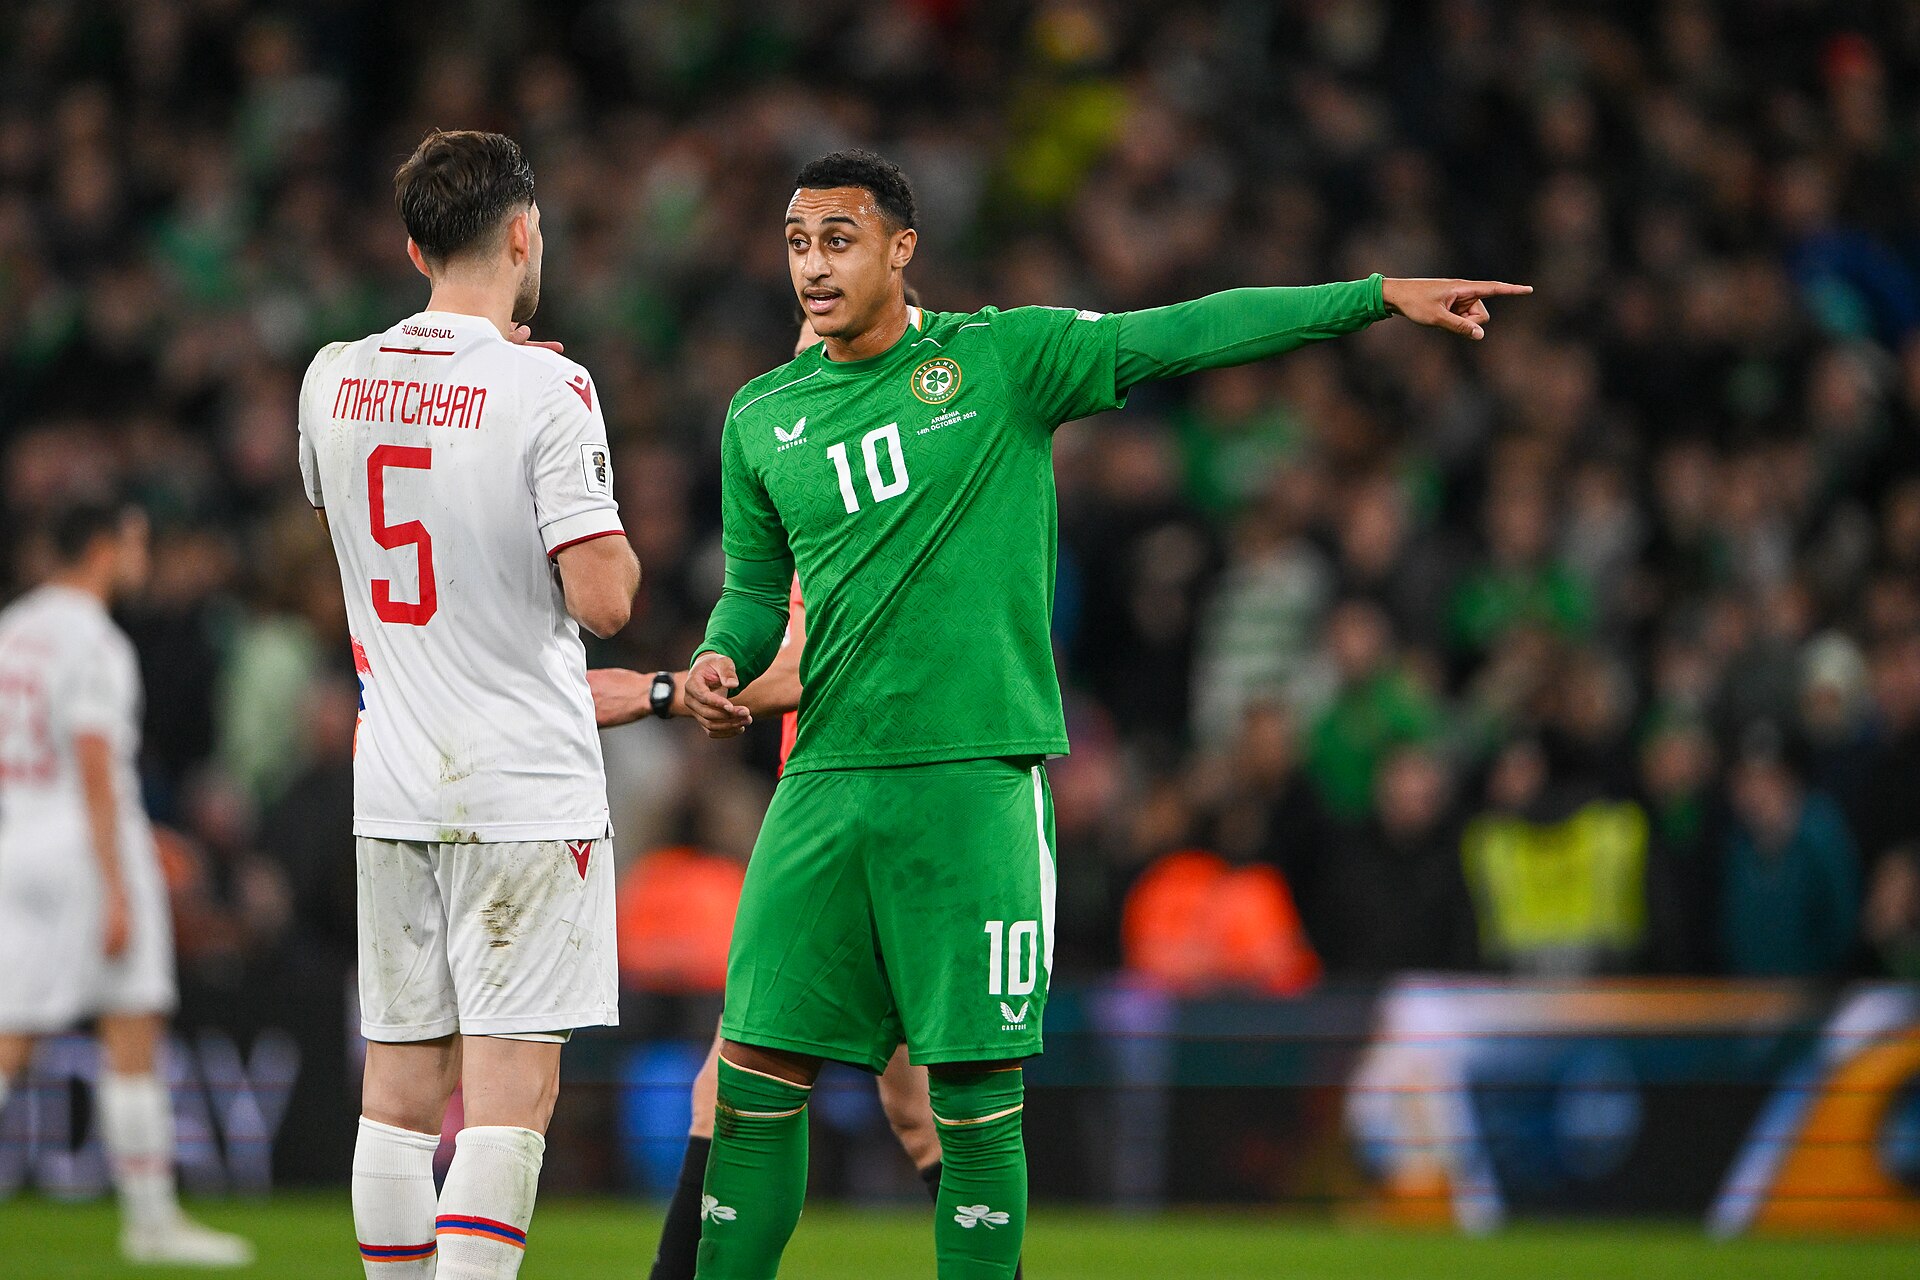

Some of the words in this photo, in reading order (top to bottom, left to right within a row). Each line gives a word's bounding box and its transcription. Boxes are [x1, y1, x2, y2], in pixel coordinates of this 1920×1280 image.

[914, 361, 955, 380] IRELAND
[332, 377, 487, 429] MKRTCHYAN
[916, 427, 930, 436] 14th
[930, 416, 962, 431] OCTOBER
[962, 410, 977, 420] 2025
[931, 410, 960, 424] ARMENIA
[826, 422, 910, 514] 10
[366, 444, 438, 626] 5
[984, 920, 1038, 995] 10
